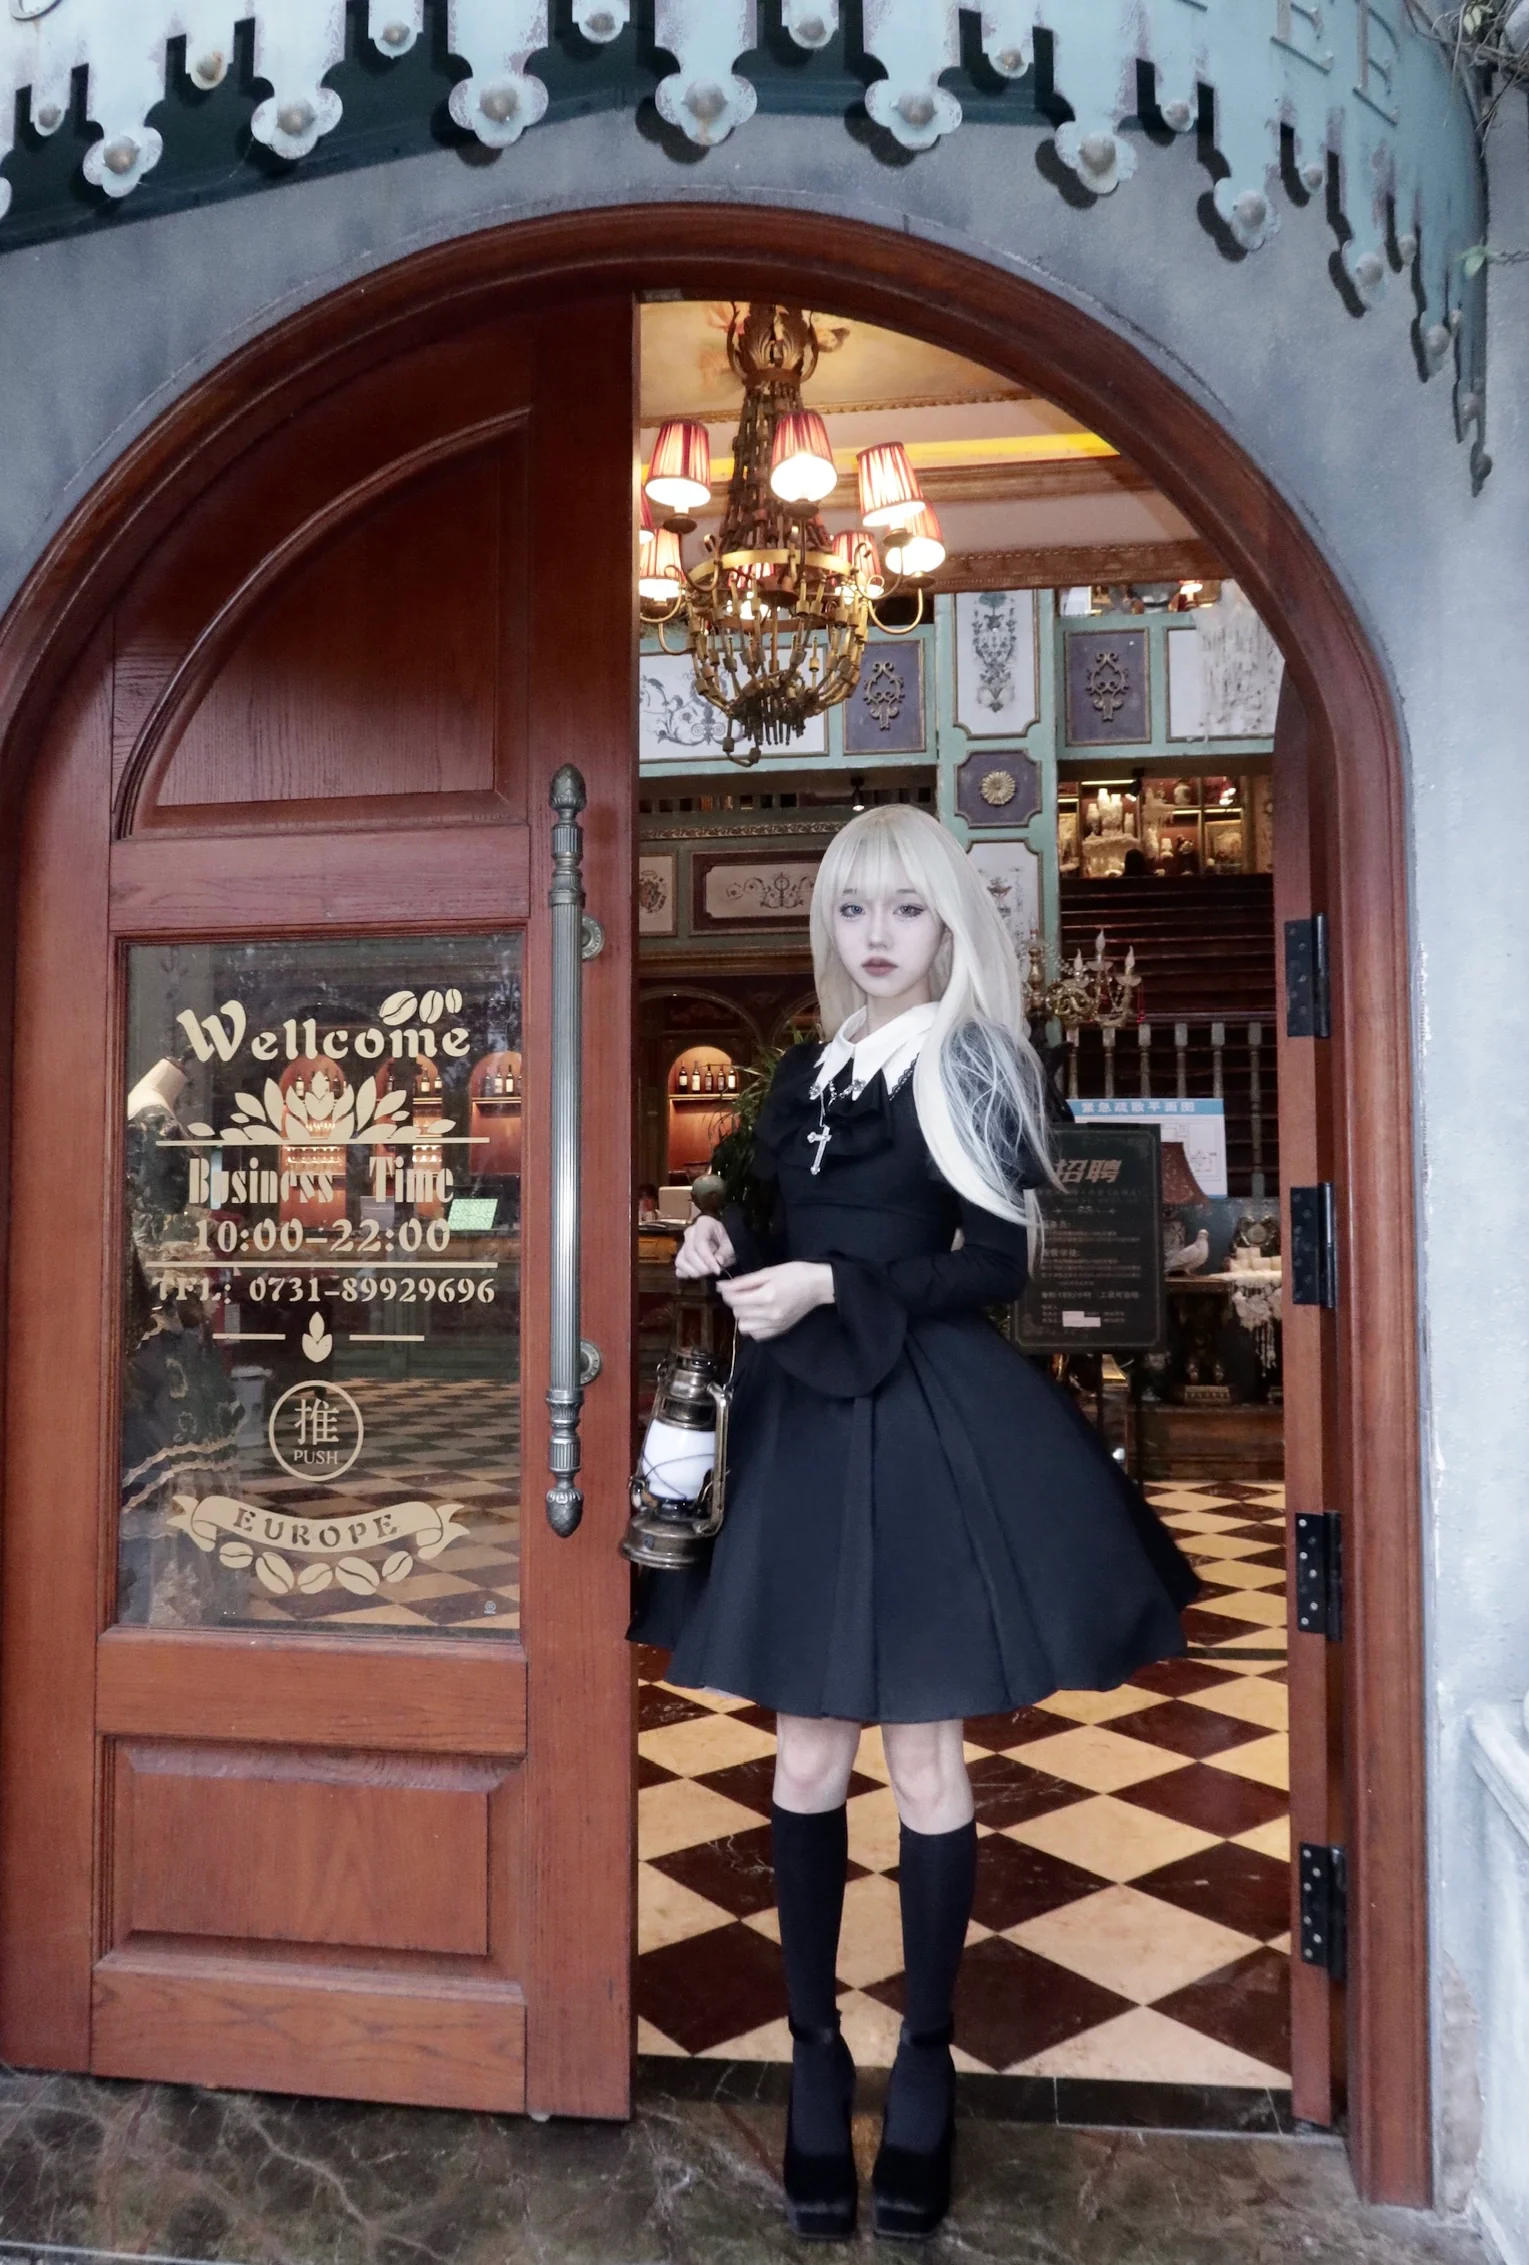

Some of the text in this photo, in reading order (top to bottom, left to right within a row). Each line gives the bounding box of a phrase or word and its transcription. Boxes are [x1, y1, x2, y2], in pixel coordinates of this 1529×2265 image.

[176, 999, 471, 1062] Wellcome
[188, 1155, 454, 1204] Business Time
[1055, 1159, 1122, 1184] 招聘
[196, 1217, 451, 1253] 10:00-22:00
[249, 1276, 496, 1304] 0731-89929696
[294, 1397, 340, 1446] 推
[293, 1449, 339, 1466] PUSH
[233, 1507, 399, 1548] EUROPE
